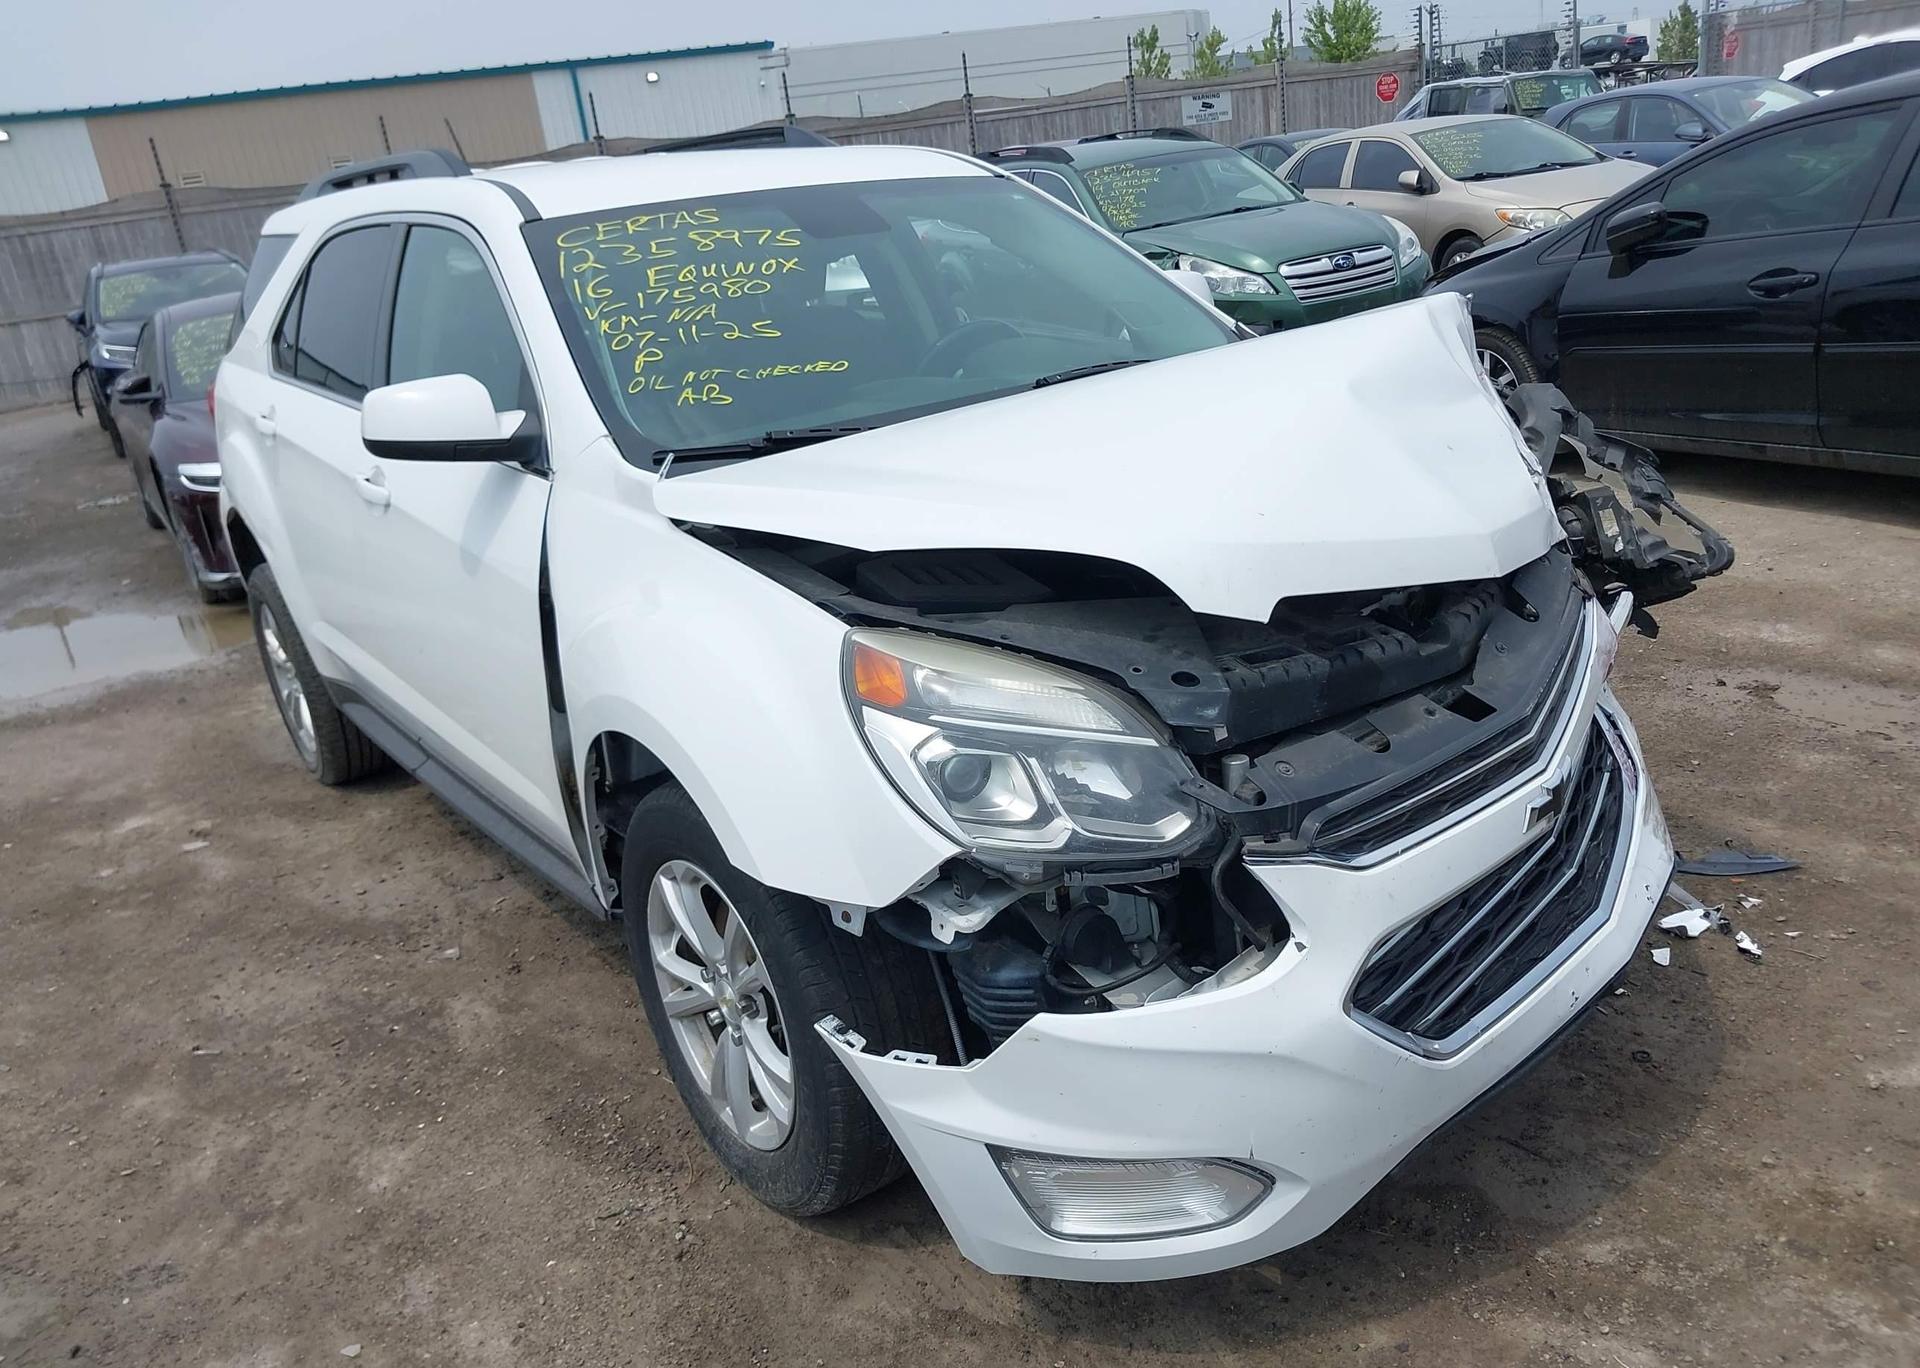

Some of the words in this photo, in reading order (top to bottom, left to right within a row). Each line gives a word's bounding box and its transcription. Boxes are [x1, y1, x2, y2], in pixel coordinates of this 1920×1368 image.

[1192, 92, 1221, 101] WARNING
[557, 208, 720, 248] CERTAS
[573, 274, 614, 304] 16
[646, 257, 806, 288] EQUINOX
[666, 303, 717, 324] N/A
[634, 348, 664, 374] P
[627, 375, 675, 394] OIL
[681, 369, 733, 386] NOT
[736, 360, 850, 380] CHECKED
